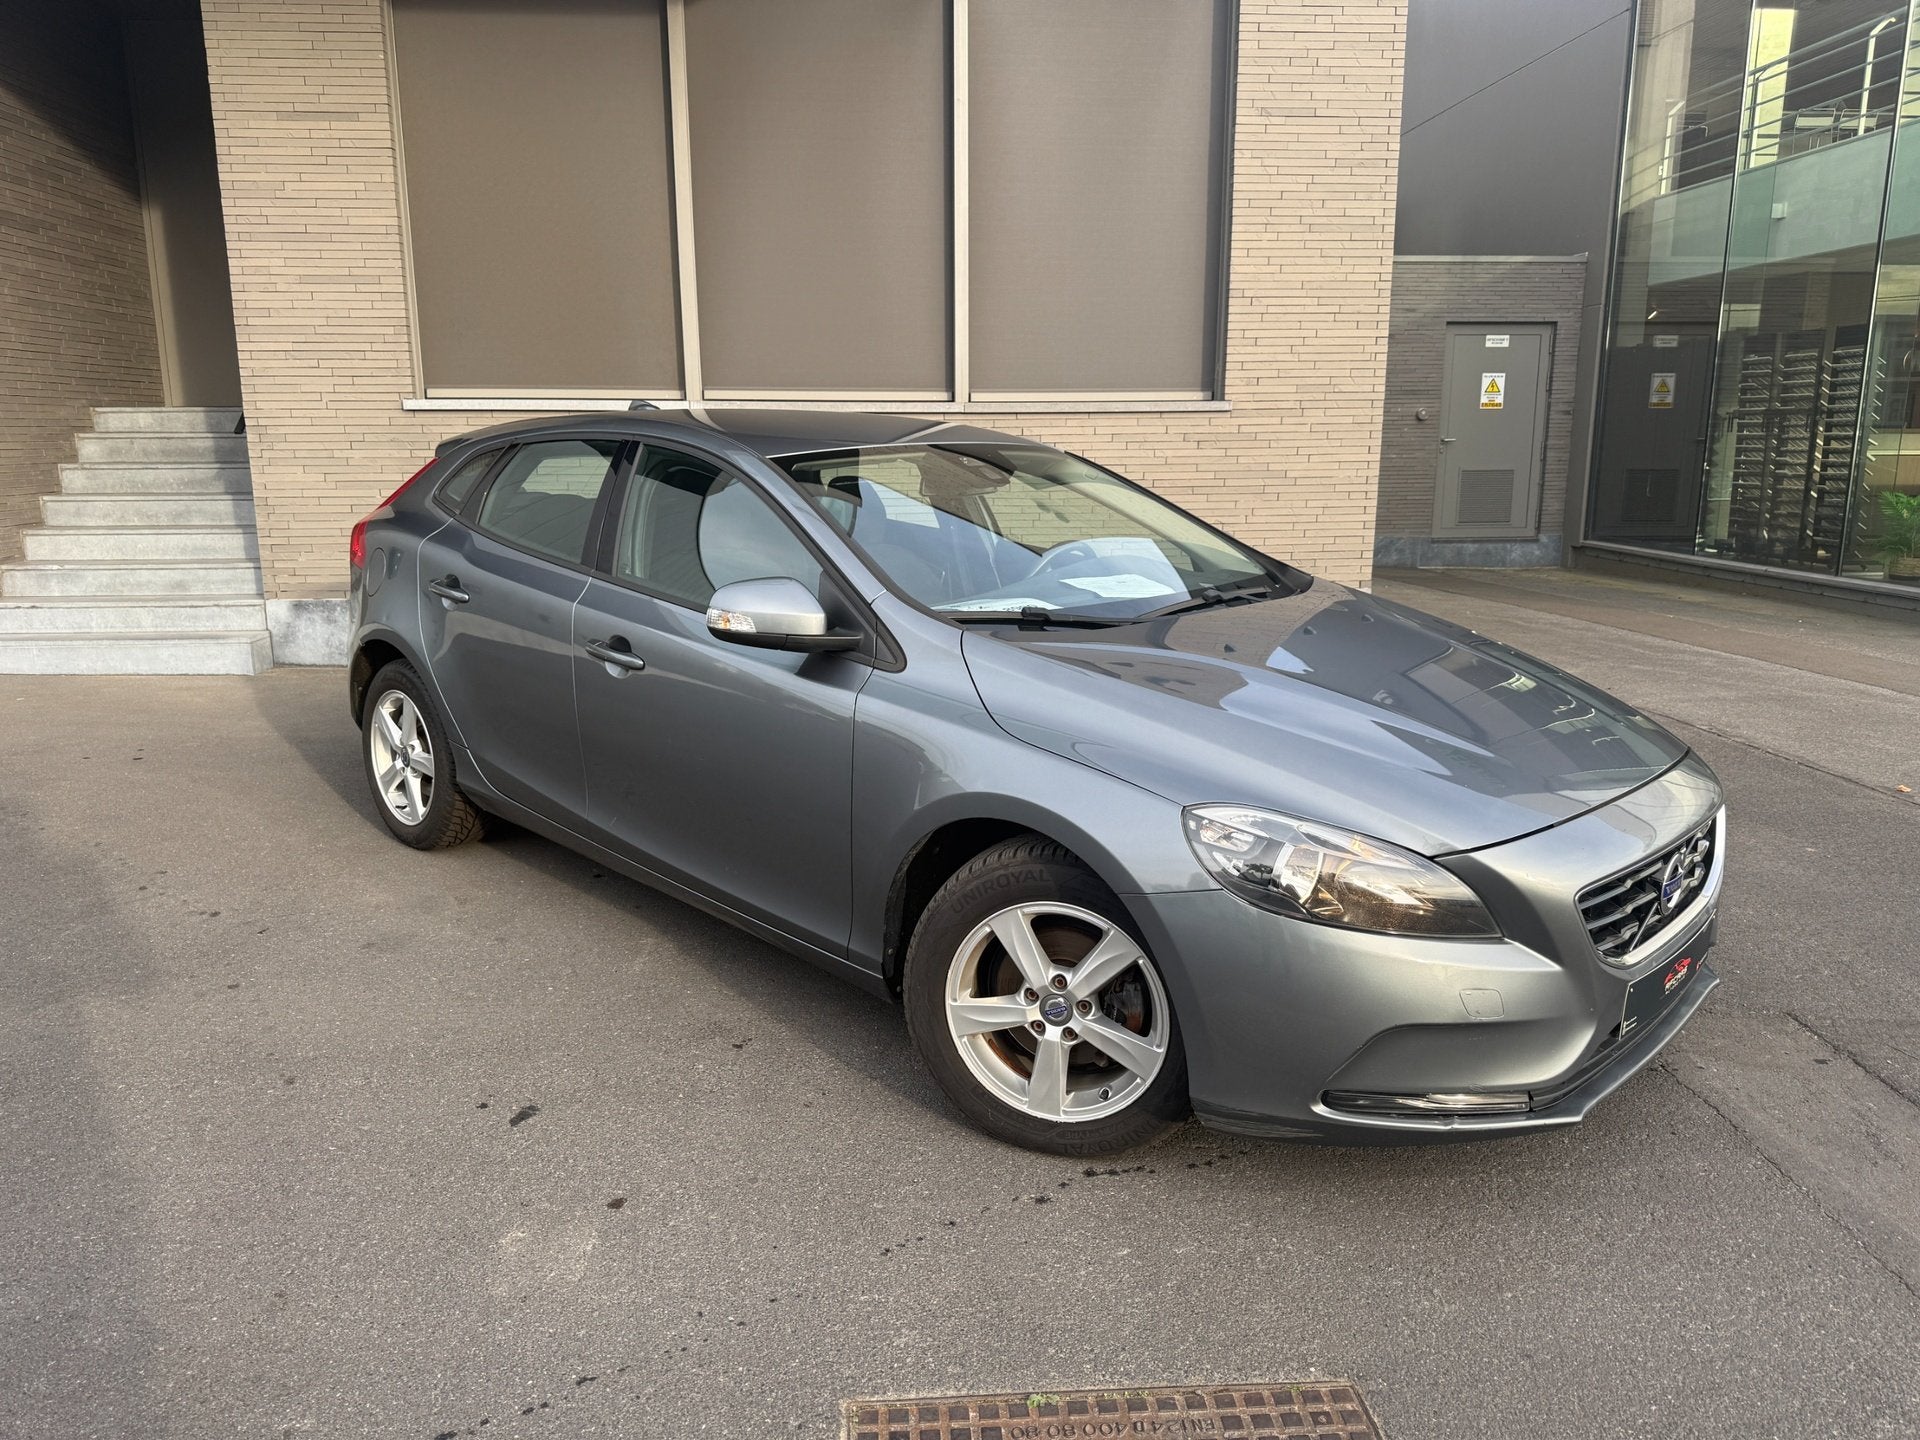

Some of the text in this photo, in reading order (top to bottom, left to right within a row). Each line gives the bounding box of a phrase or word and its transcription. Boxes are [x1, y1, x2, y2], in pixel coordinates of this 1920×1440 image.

[950, 868, 1050, 914] UNIROYAL
[1011, 1425, 1040, 1440] 80
[1047, 1423, 1076, 1439] 80
